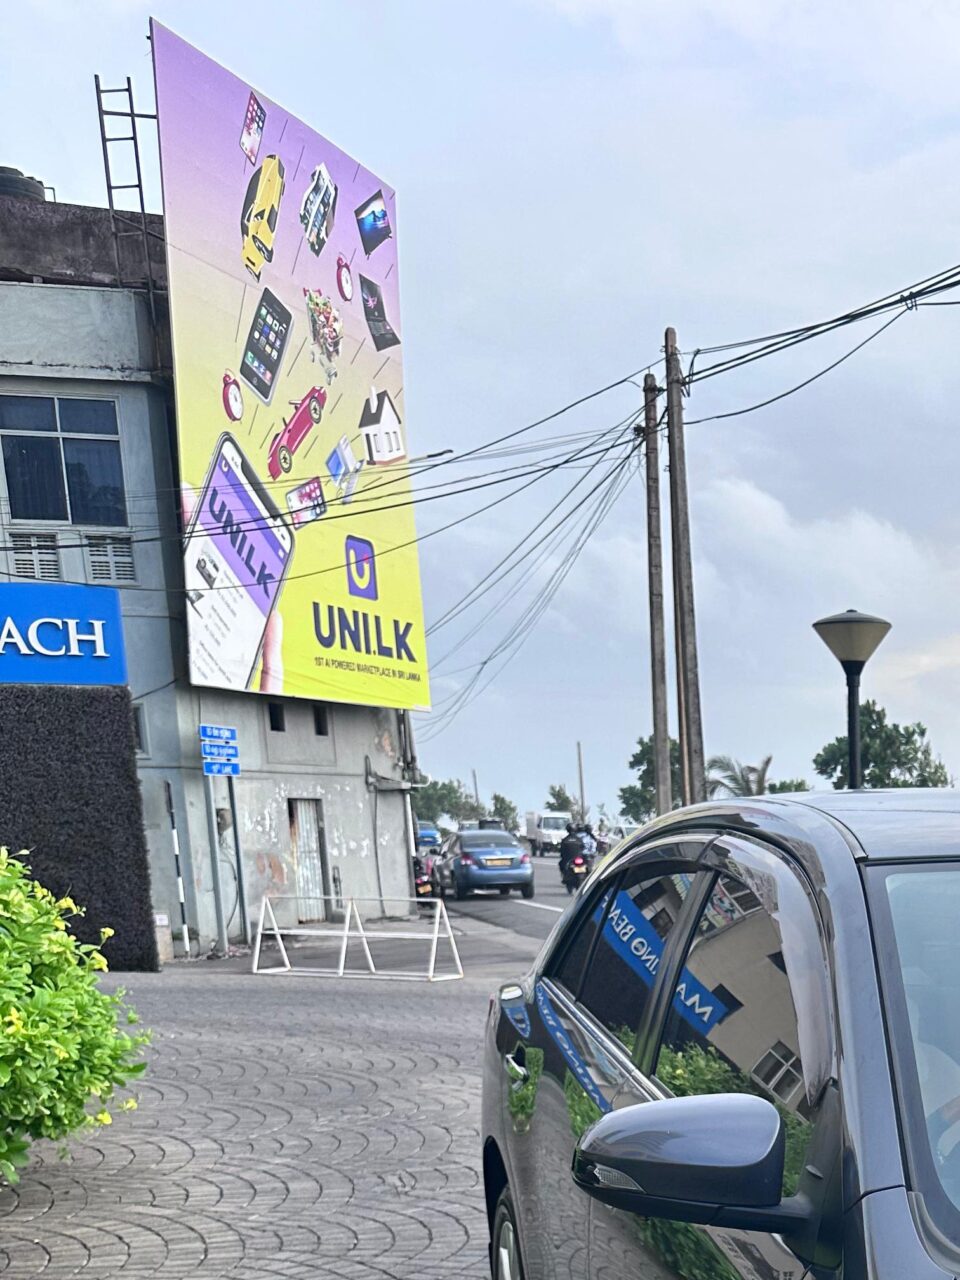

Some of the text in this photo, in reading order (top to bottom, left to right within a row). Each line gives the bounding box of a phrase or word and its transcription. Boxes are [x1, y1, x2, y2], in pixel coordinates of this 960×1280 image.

[208, 486, 276, 600] UNI.LK
[0, 616, 110, 657] ACH
[312, 601, 418, 663] UNI.LK
[314, 656, 324, 667] 1ST
[331, 658, 356, 672] POWERED
[356, 663, 392, 678] MARKETPLACE
[397, 670, 405, 679] SRI
[405, 672, 421, 682] LANKA
